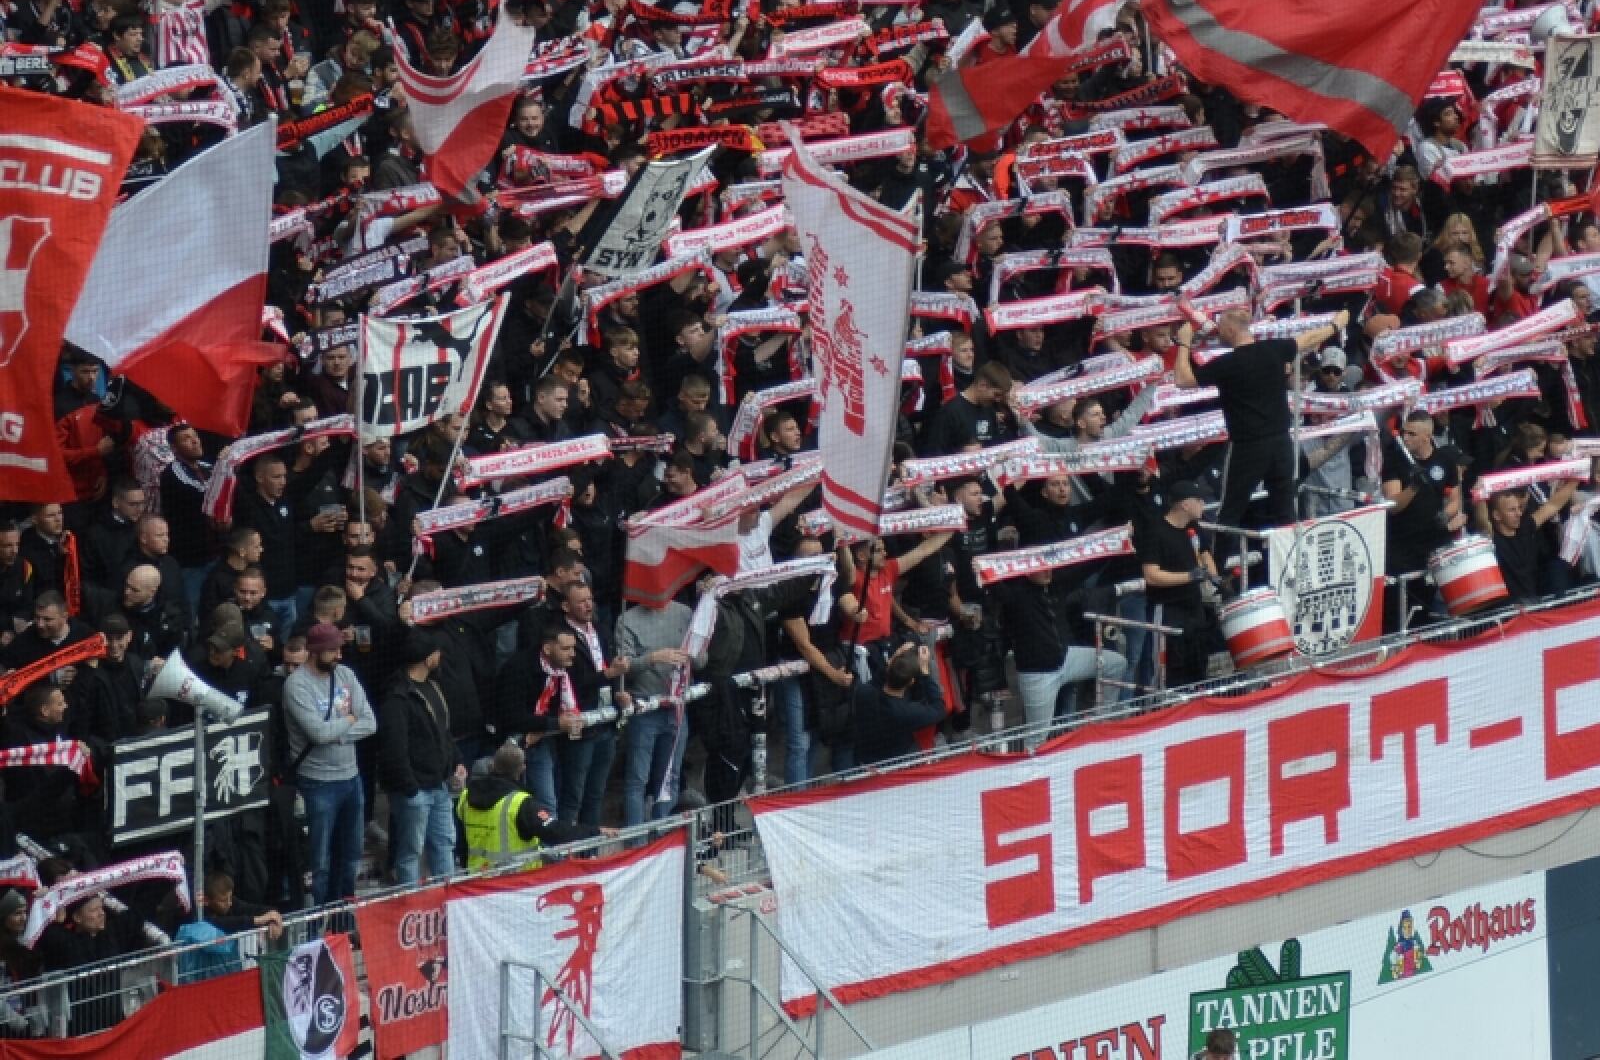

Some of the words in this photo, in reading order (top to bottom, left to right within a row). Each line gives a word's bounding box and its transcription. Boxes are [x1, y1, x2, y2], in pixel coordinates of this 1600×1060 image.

[1425, 896, 1538, 958] Rothaus
[377, 979, 448, 1025] Nostr
[1196, 981, 1344, 1033] TANNEN
[1234, 1026, 1338, 1060] PFLE
